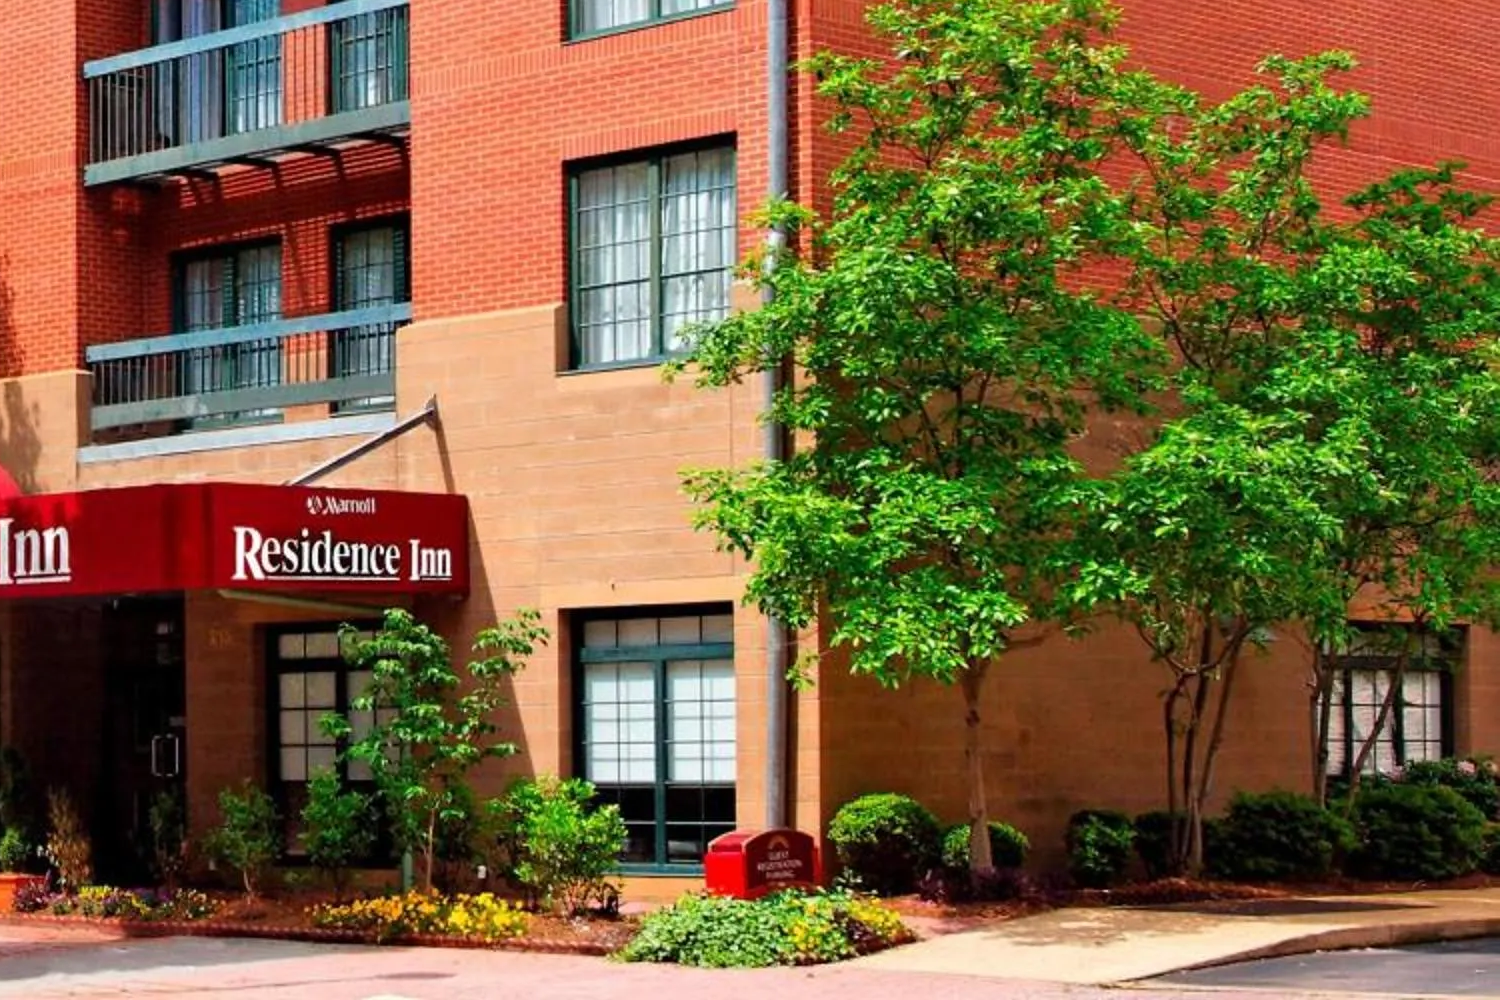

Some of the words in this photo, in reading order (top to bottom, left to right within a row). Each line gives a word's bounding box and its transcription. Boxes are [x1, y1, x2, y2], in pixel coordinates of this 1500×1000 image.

[322, 496, 376, 514] Marriott
[231, 526, 400, 581] Residence
[409, 539, 452, 581] Inn
